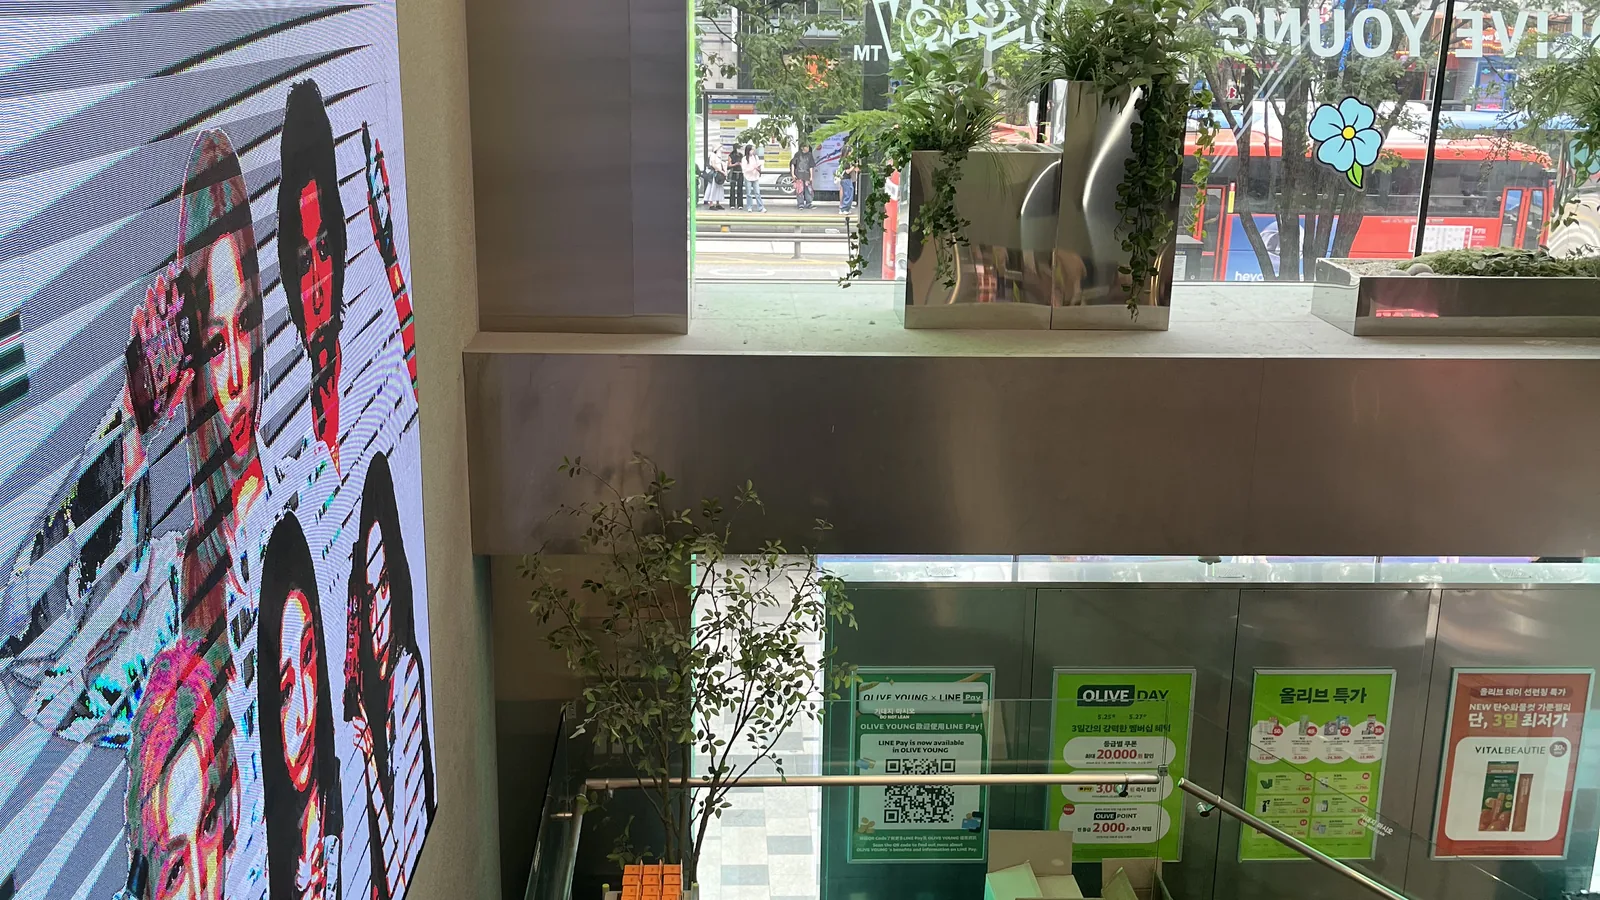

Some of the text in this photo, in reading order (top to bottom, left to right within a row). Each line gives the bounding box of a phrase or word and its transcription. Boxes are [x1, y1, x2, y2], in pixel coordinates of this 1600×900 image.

[1082, 690, 1169, 702] OLIVE DAY
[1280, 687, 1367, 704] 올리브 특가
[1480, 688, 1504, 696] 올리브
[1506, 688, 1522, 696] 데이
[1550, 688, 1566, 696] 특가
[1468, 712, 1568, 729] 단, 3일 최저가
[1072, 724, 1101, 733] 3일간의
